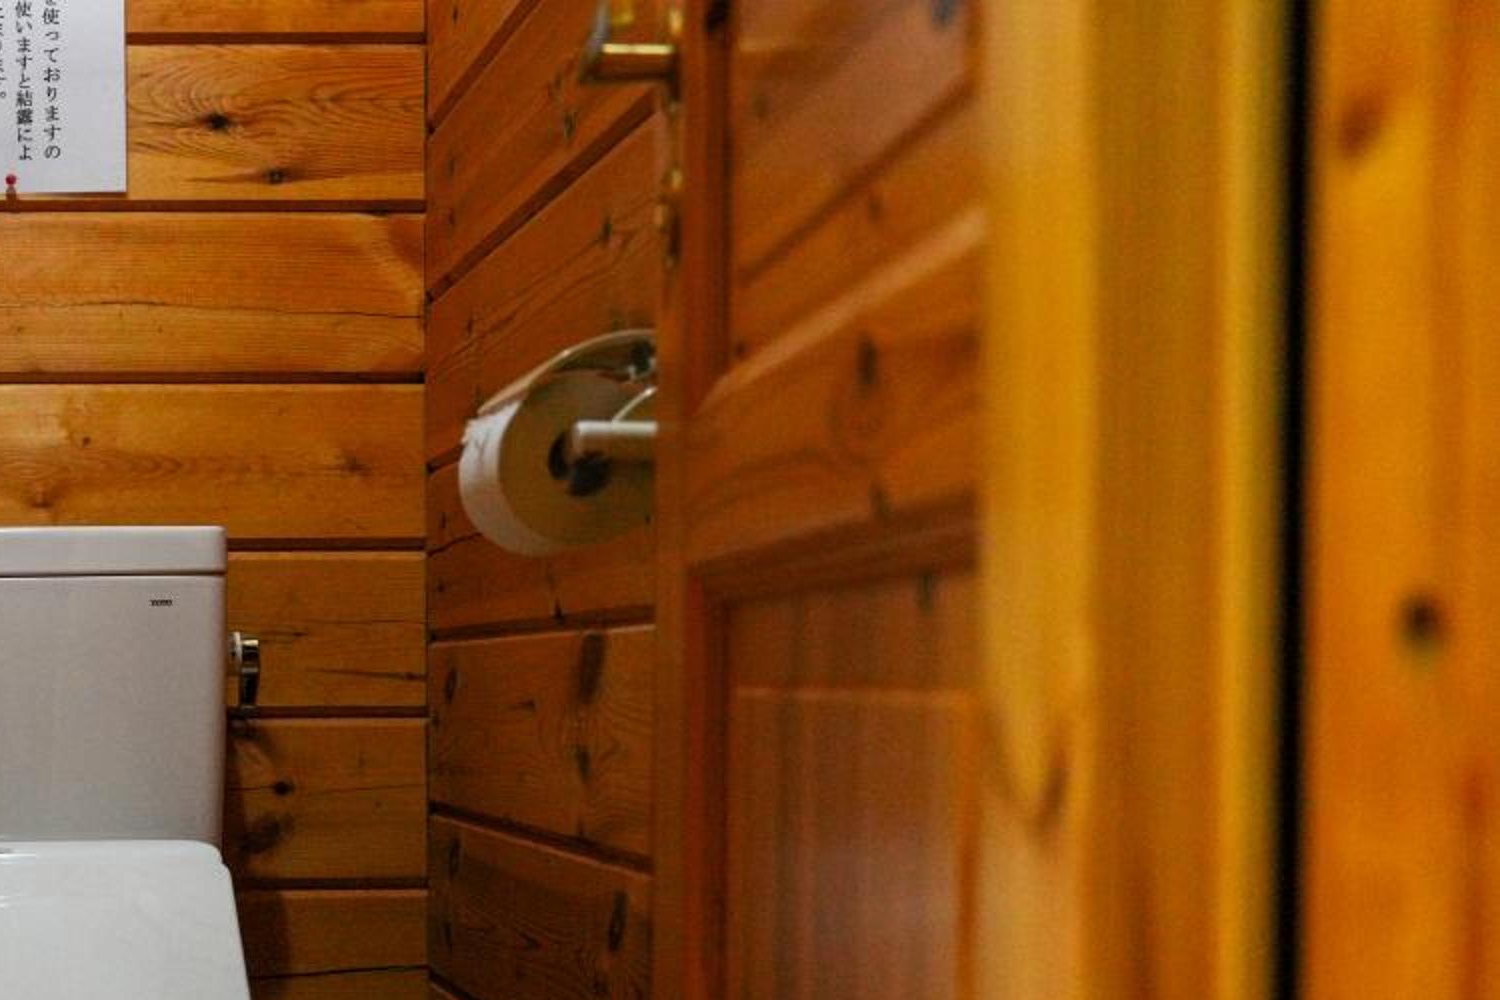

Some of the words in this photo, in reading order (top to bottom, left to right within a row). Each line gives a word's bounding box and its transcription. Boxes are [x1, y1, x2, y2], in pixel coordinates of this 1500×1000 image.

[42, 0, 61, 159] 使っておりますの
